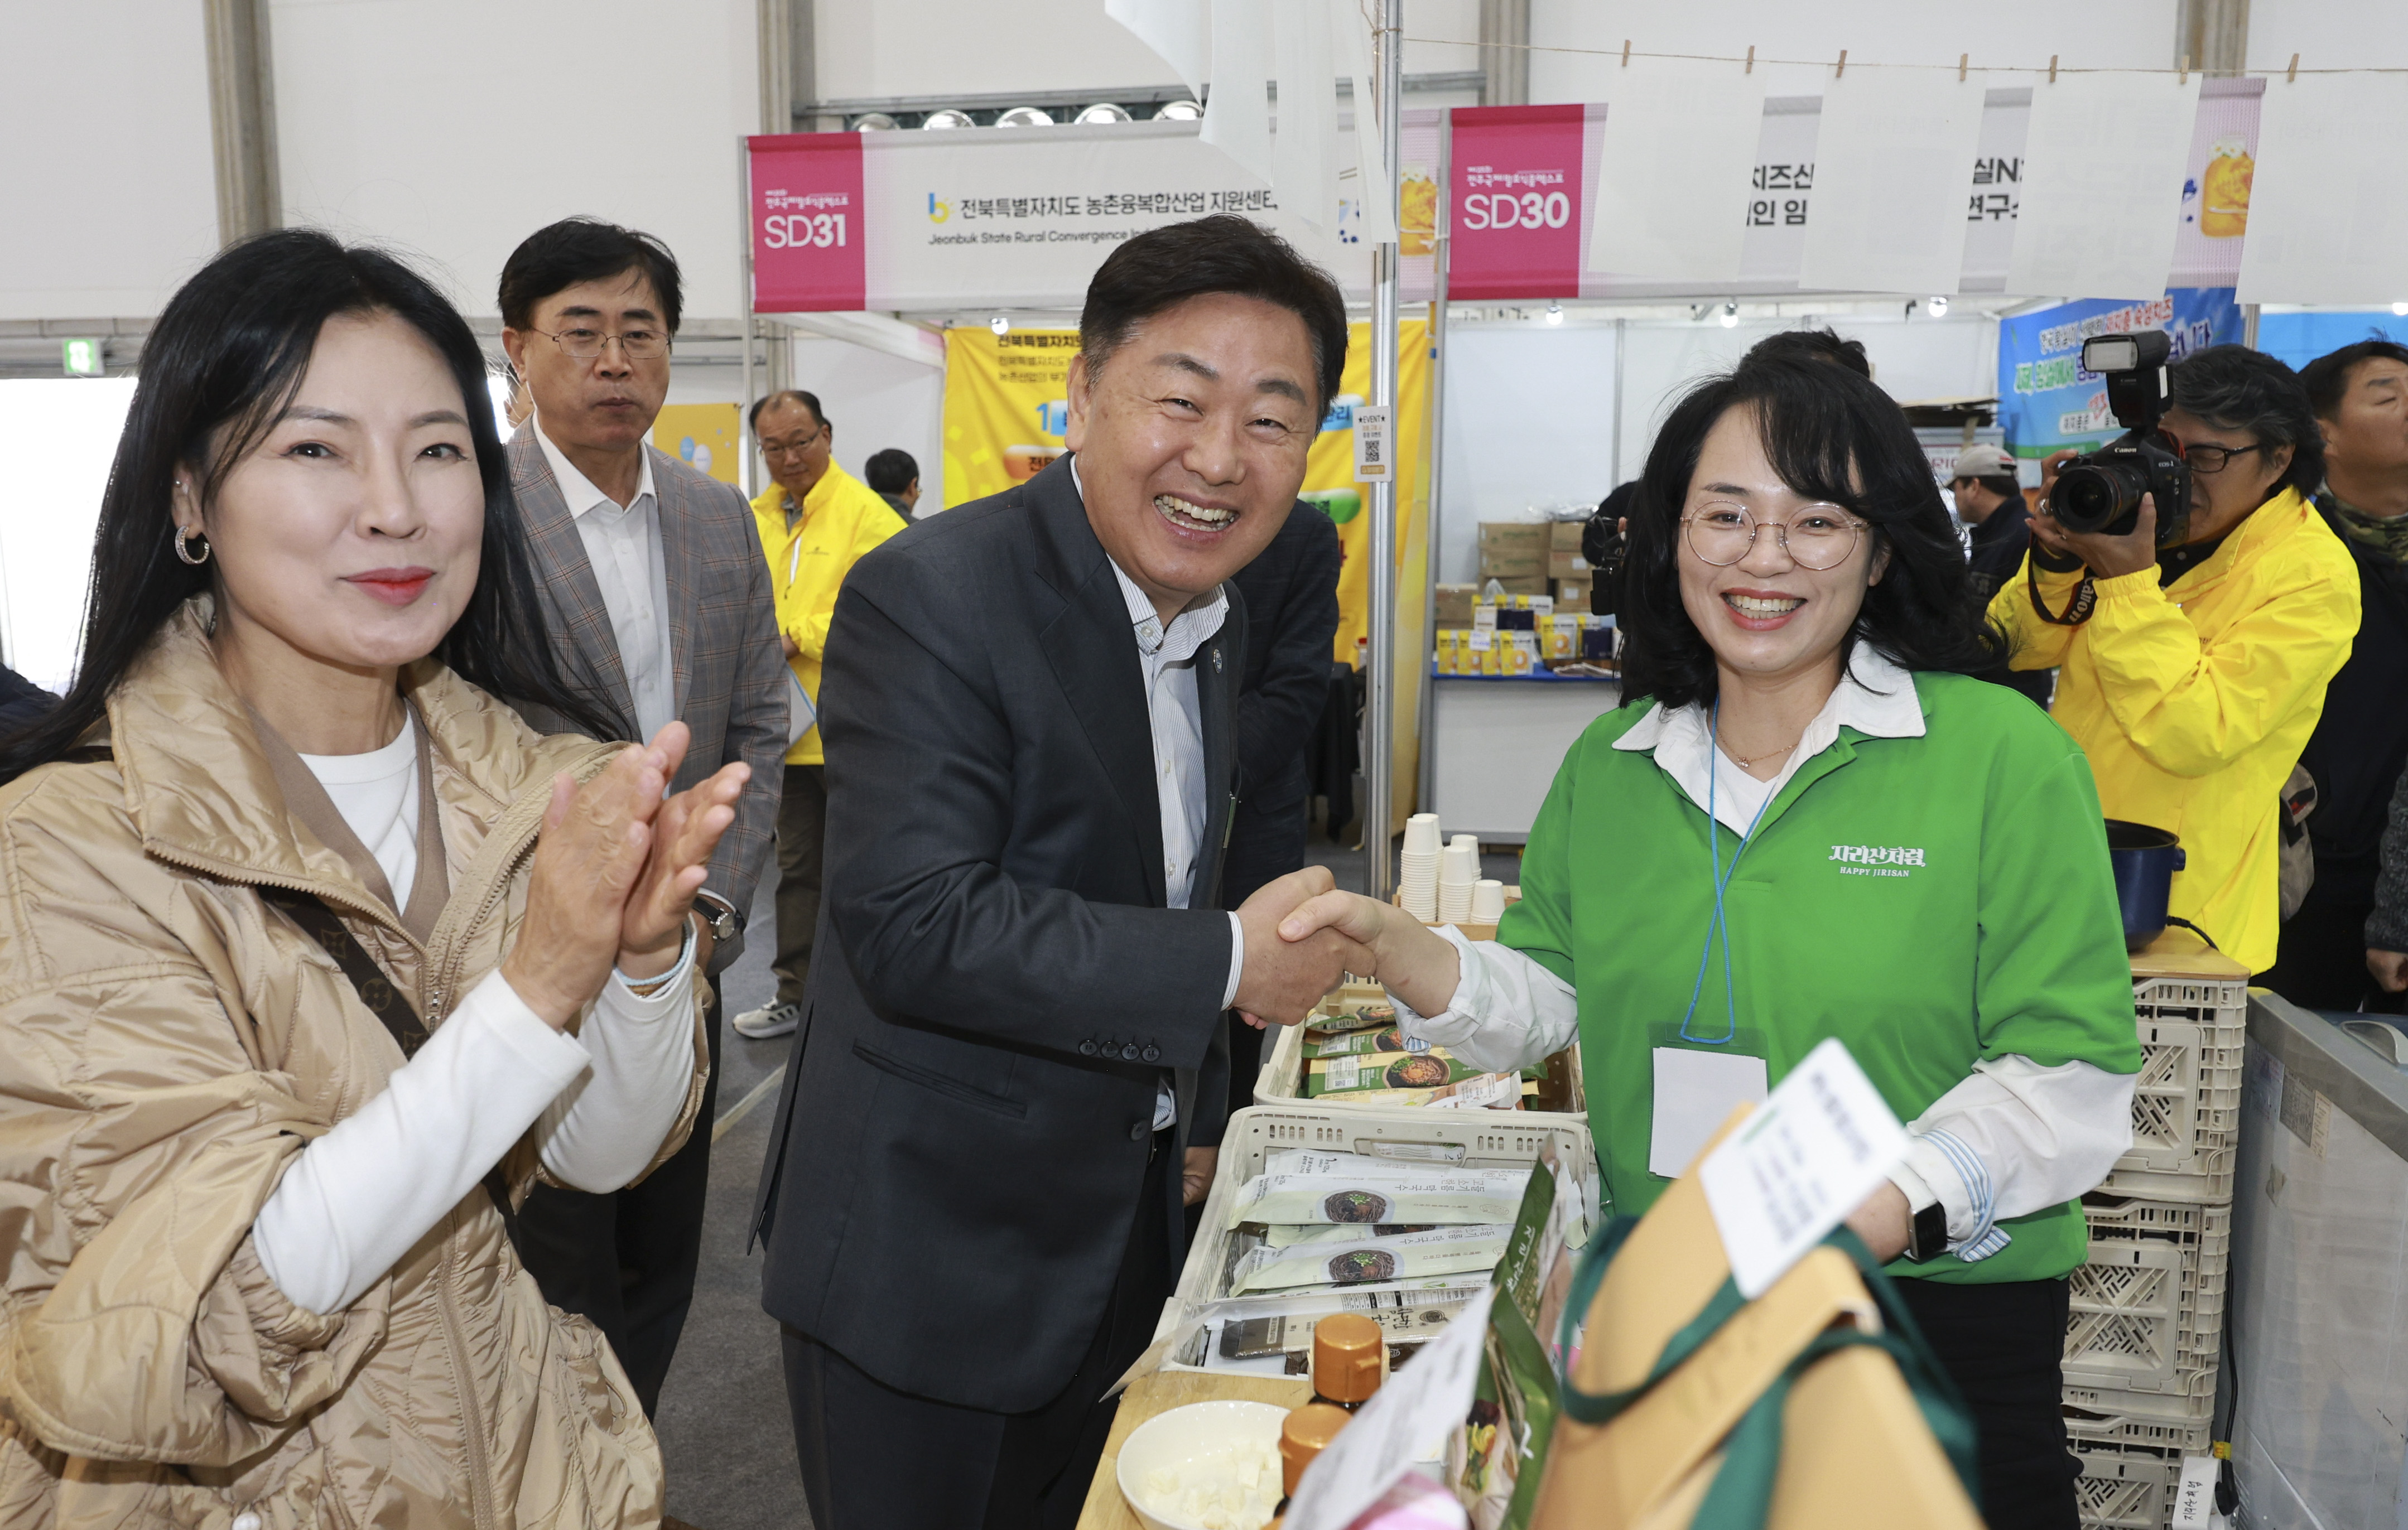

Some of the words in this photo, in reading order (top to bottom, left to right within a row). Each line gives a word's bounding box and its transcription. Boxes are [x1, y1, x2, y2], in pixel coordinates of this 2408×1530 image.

[960, 196, 1081, 219] 전북특별자치도
[1087, 193, 1206, 215] 농촌융복합산업
[1463, 191, 1571, 230] SD30
[764, 213, 846, 249] SD31
[928, 233, 977, 245] Jeonbuk
[981, 231, 1012, 244] State
[1014, 230, 1046, 243] Rural
[1048, 228, 1127, 244] Convergence
[1362, 415, 1380, 423] EVENT
[1828, 845, 1926, 867] 지리산처럼
[1839, 866, 1870, 876] HAPPY
[1872, 868, 1910, 877] JIRISAN
[1399, 1235, 1444, 1245] 막국수
